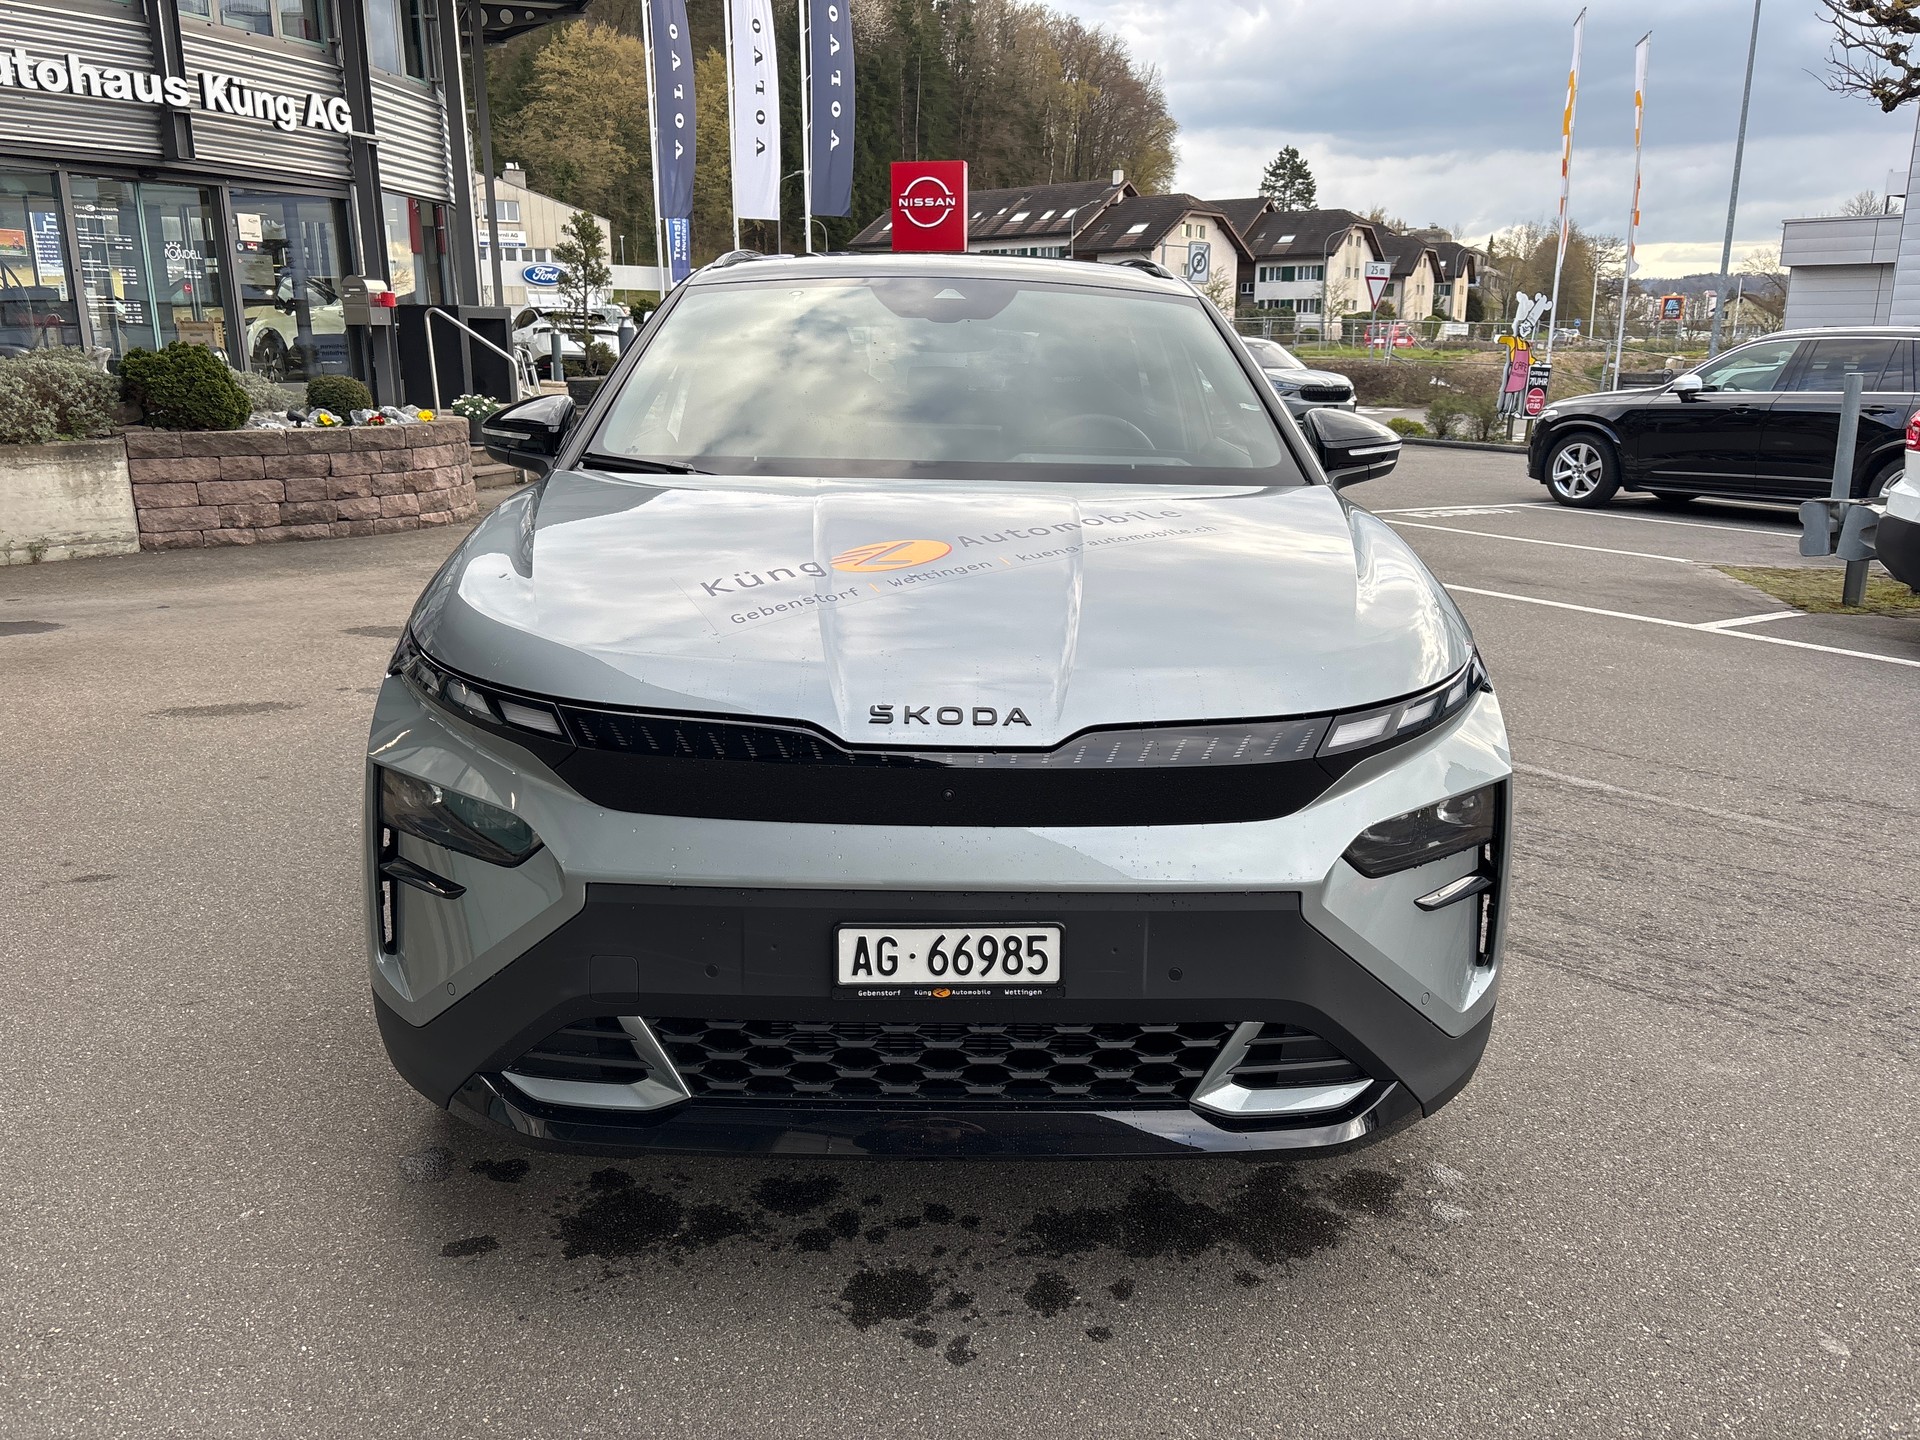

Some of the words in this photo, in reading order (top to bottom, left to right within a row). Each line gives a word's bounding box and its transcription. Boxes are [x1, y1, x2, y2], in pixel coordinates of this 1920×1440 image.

[0, 48, 190, 107] tohaus
[199, 72, 297, 132] Küng
[303, 93, 353, 134] AG
[668, 23, 685, 160] VOLVO
[751, 18, 766, 157] VOLVO
[828, 4, 842, 152] VOLVO
[898, 197, 956, 207] NISSAN
[532, 266, 560, 281] Ford
[1370, 265, 1379, 275] 25
[700, 561, 828, 597] Küng
[957, 508, 1182, 548] Automobile
[730, 587, 859, 624] Gebenstorf
[887, 560, 993, 588] Wettingen
[1016, 524, 1218, 562] kueng-automobile.ch
[851, 935, 899, 976] AG
[927, 934, 1049, 977] 66985
[858, 989, 901, 997] Gebenstorf
[914, 988, 932, 998] Küng
[951, 988, 992, 996] Automobile
[1004, 988, 1043, 998] Wettingen
